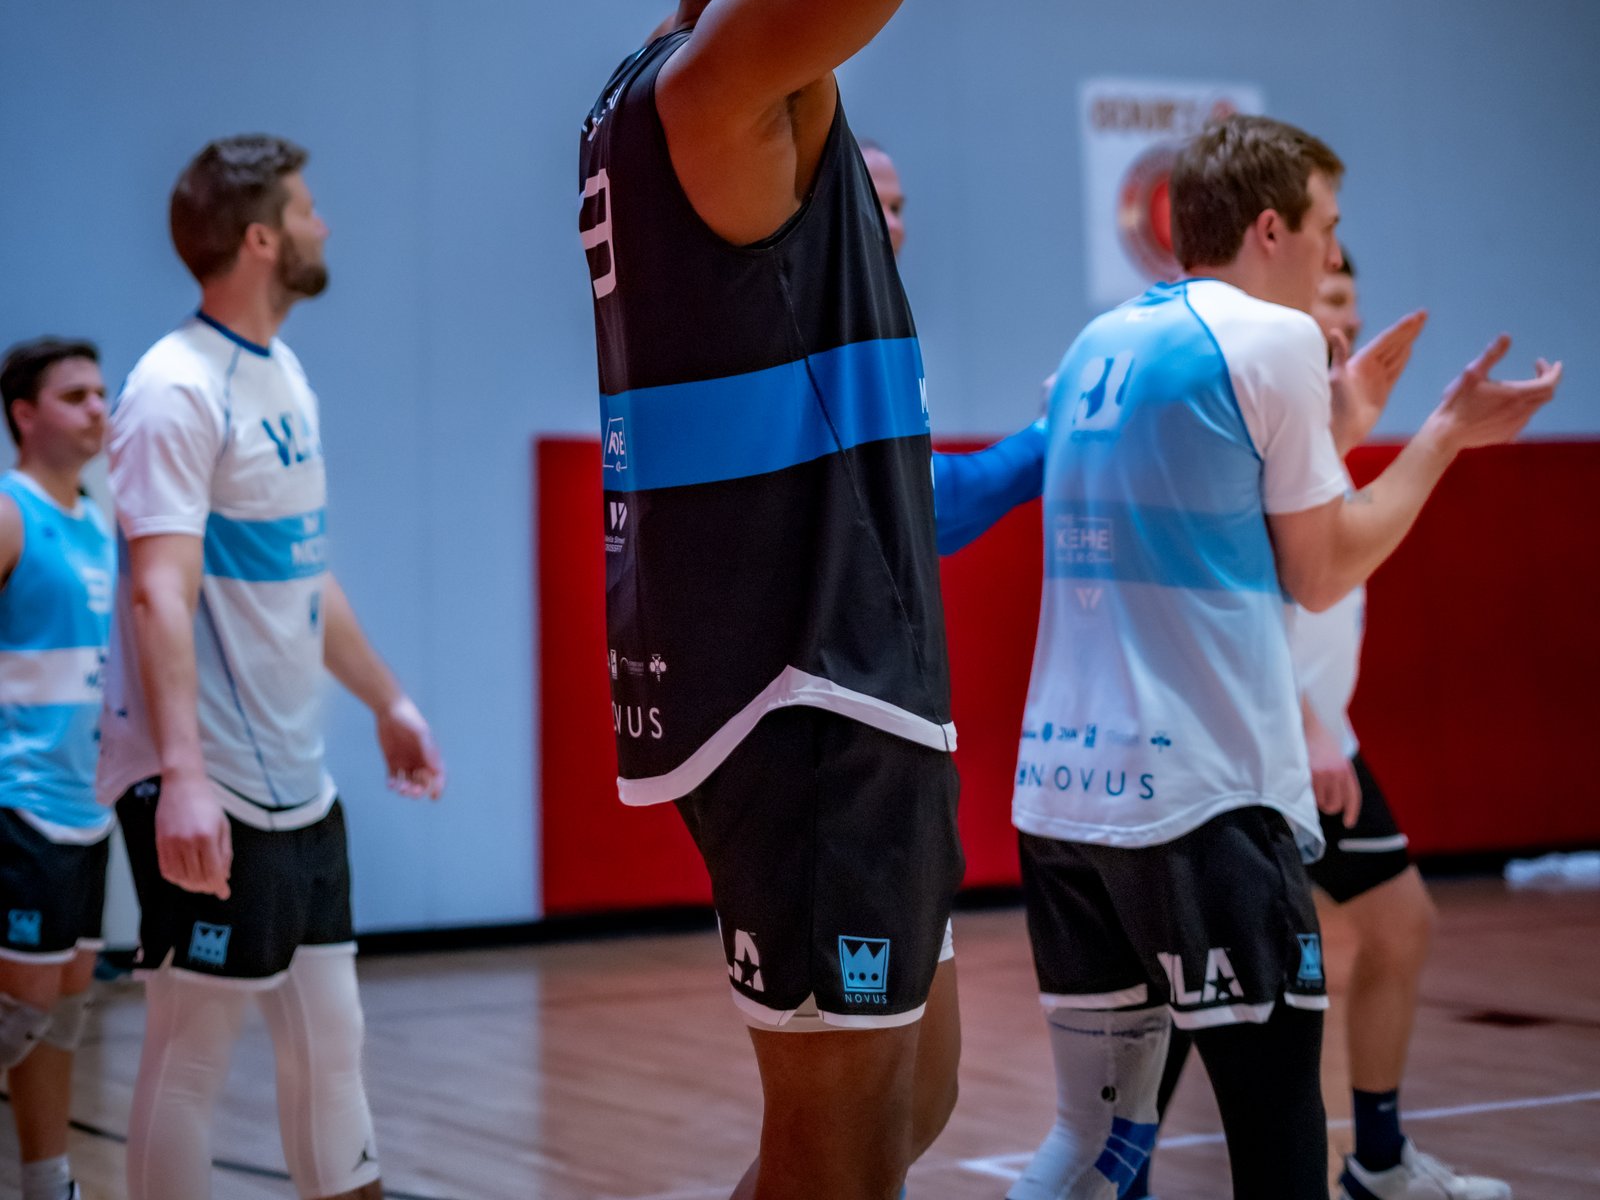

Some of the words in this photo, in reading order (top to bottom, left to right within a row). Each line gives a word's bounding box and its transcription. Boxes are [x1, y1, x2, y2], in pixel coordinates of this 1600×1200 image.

[612, 700, 663, 739] VUS
[1028, 762, 1154, 800] NOVUS
[844, 993, 888, 1005] NOVUS
